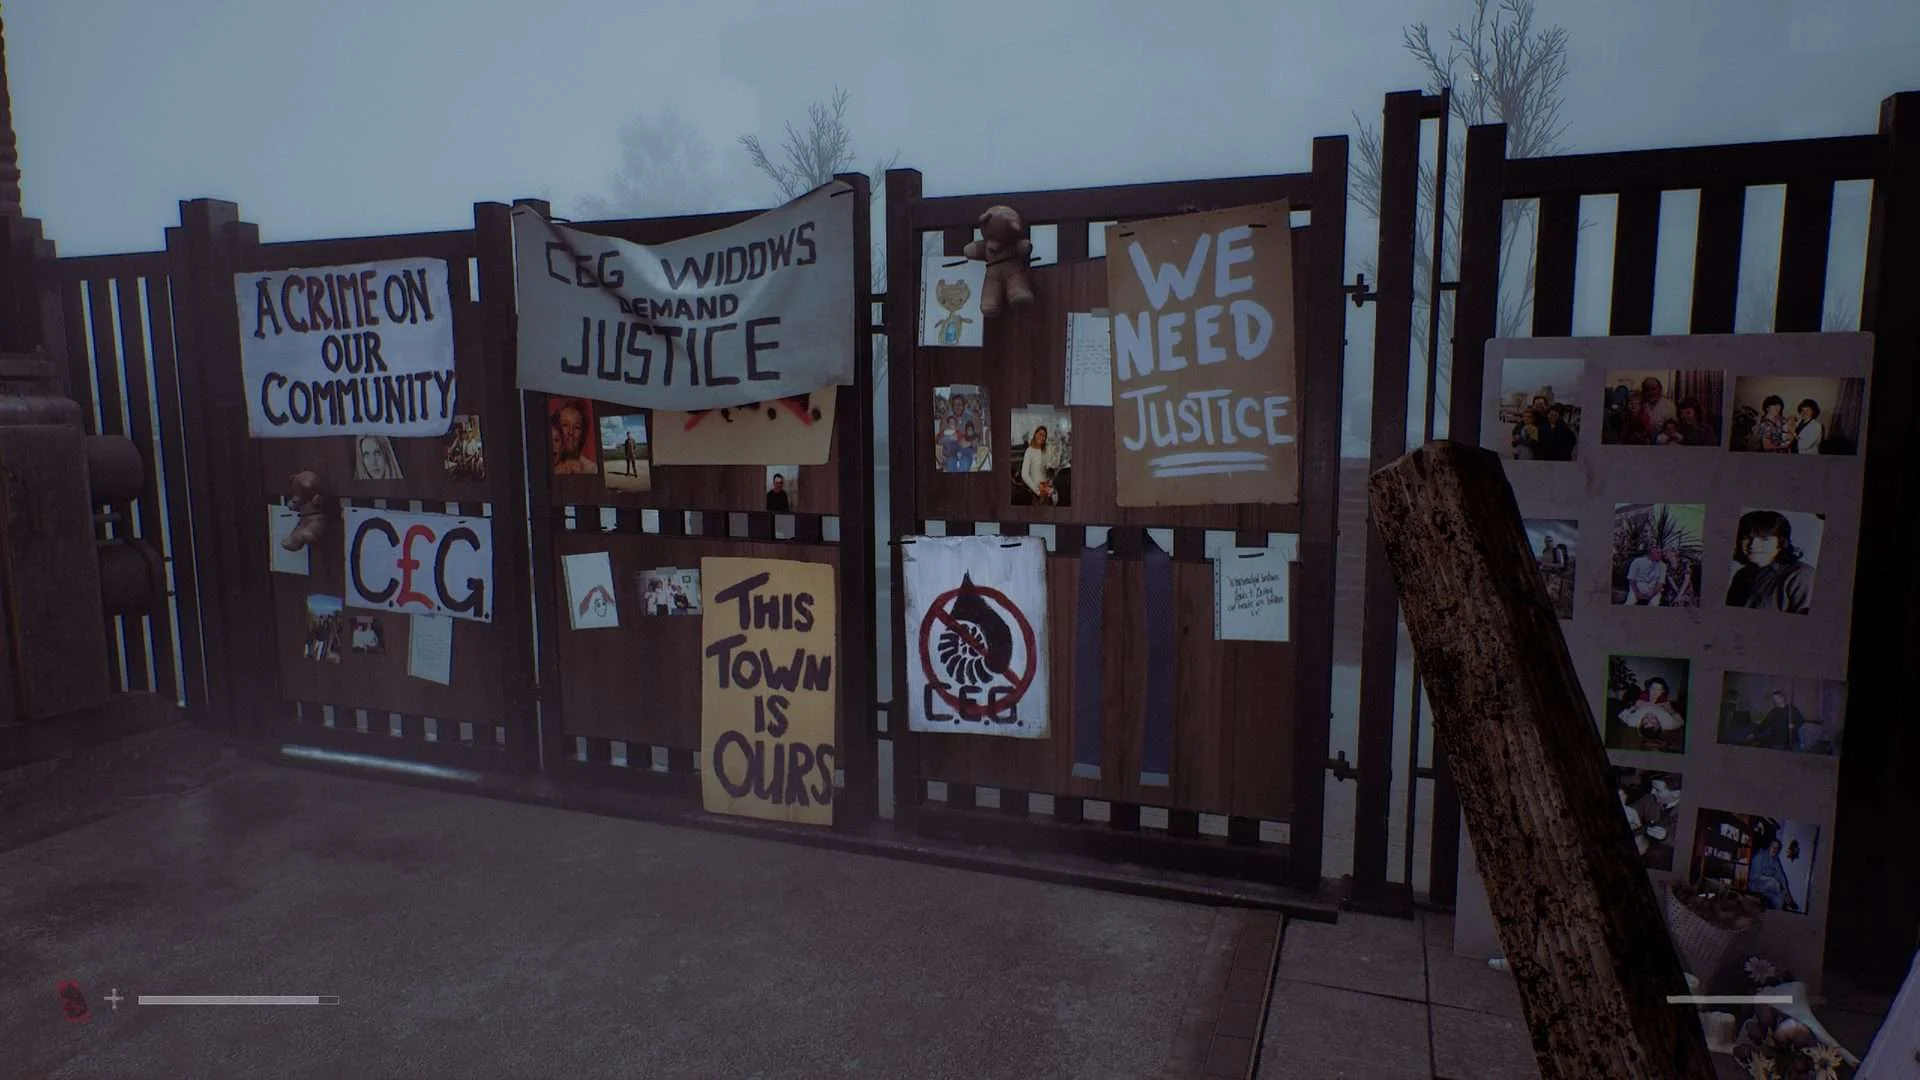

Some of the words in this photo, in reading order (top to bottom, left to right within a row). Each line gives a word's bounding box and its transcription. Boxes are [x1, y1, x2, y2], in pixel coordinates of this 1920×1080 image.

[545, 240, 625, 289] CEG
[660, 221, 818, 290] WIDOWS
[1127, 225, 1255, 311] WE
[254, 277, 284, 340] A
[280, 269, 380, 333] CRIME
[383, 268, 434, 325] ON
[620, 293, 740, 321] DEMAND
[321, 330, 388, 374] OUR
[560, 315, 782, 387] JUSTICE
[1113, 300, 1274, 382] NEED
[261, 369, 456, 426] COMMUNITY
[714, 571, 815, 633] THIS
[705, 633, 832, 693] TOWN
[753, 694, 792, 739] IS
[712, 729, 836, 808] OURS
